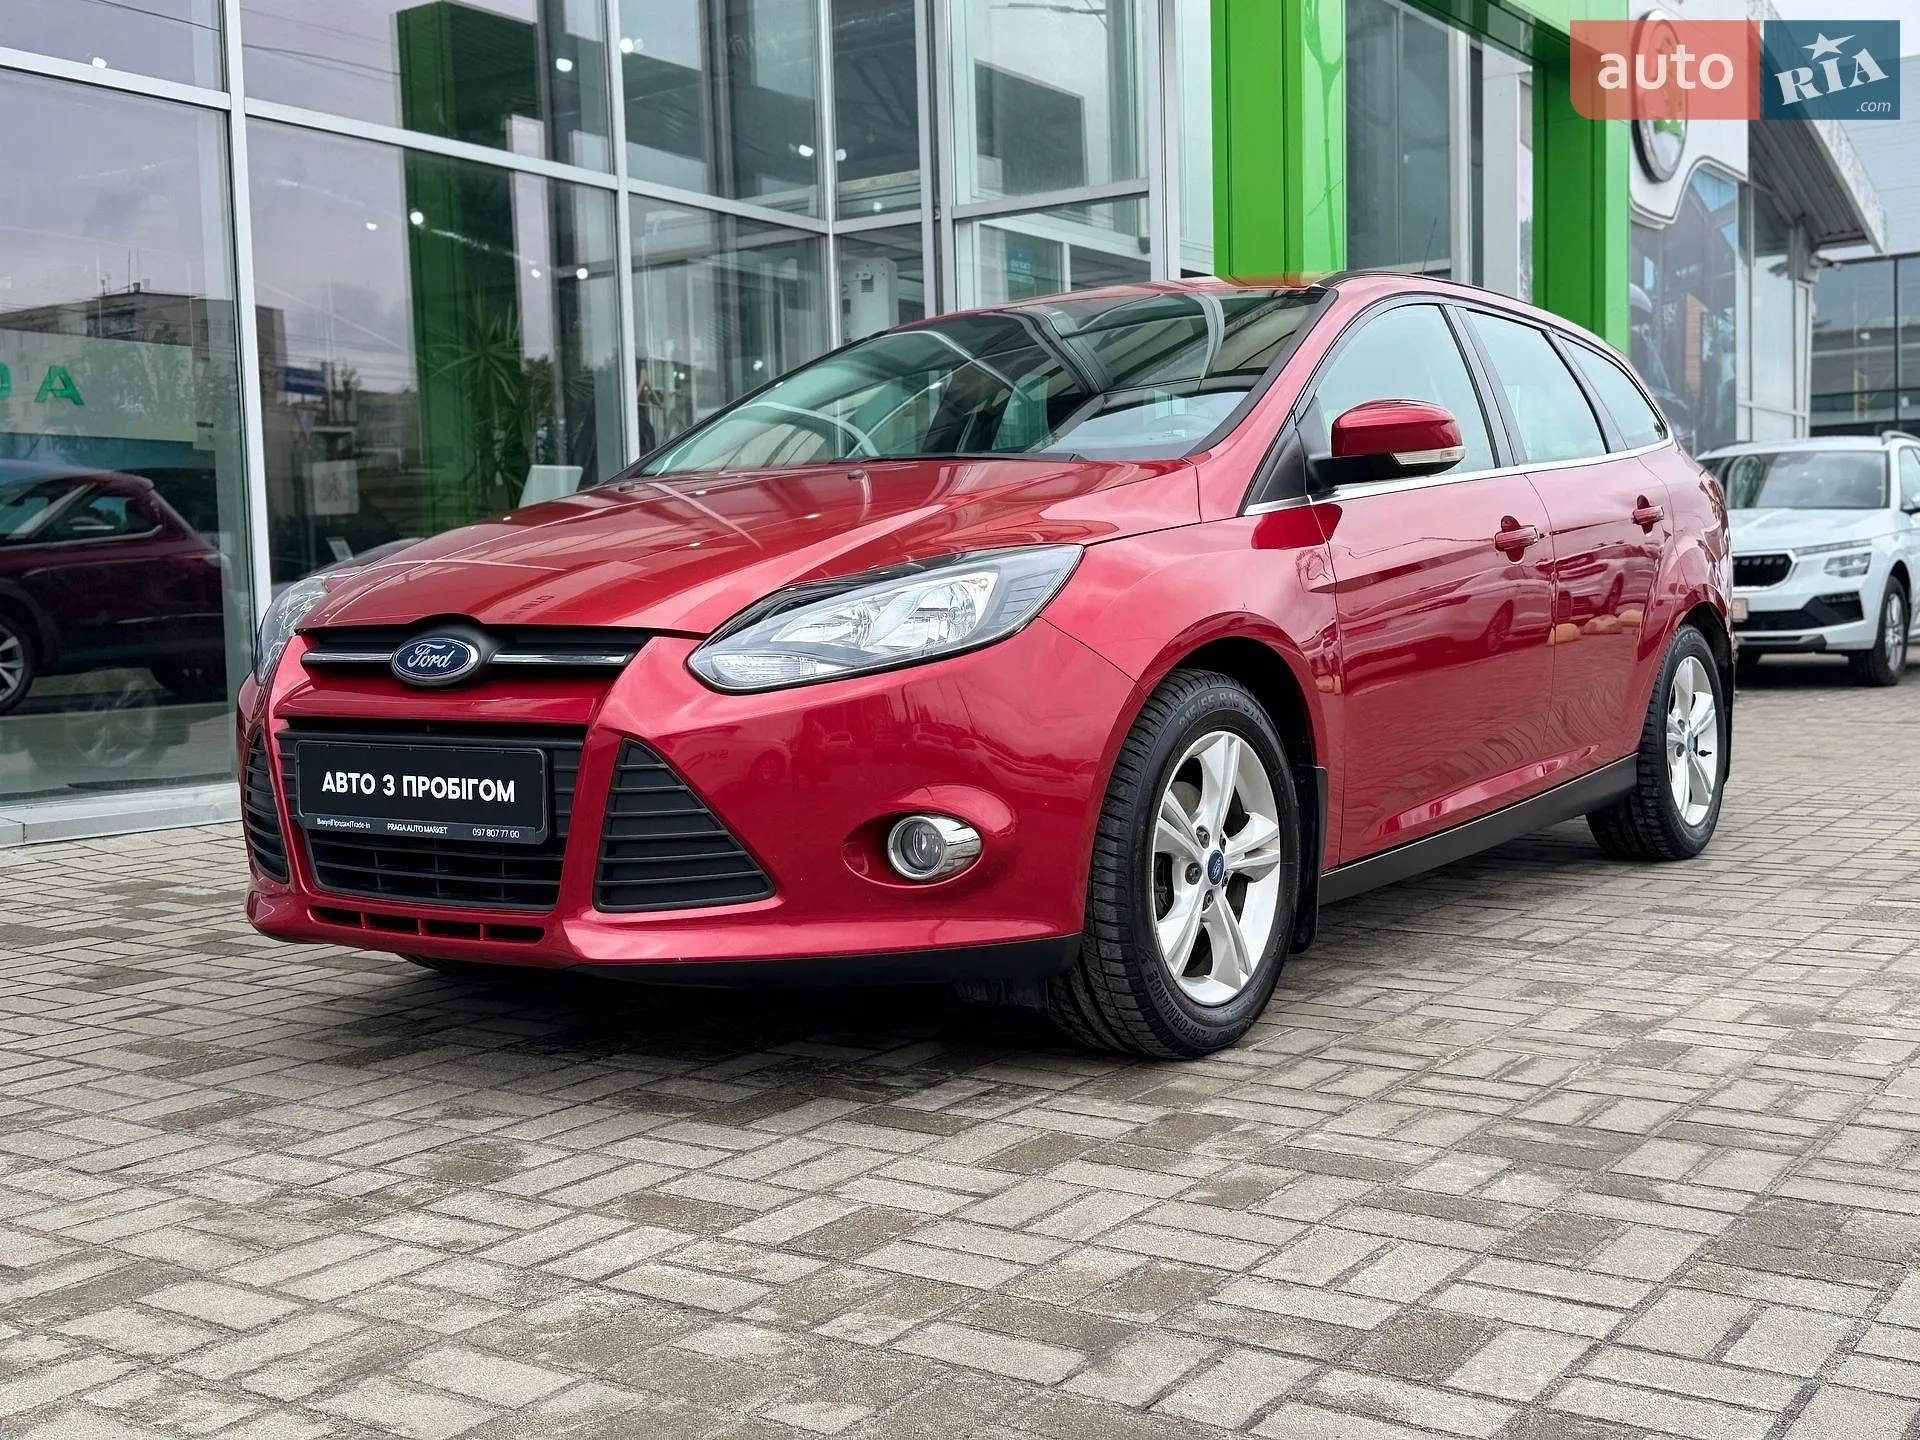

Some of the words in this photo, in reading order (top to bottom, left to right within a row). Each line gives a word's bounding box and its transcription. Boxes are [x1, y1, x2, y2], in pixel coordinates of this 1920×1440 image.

[0, 362, 84, 406] A
[407, 643, 456, 668] Ford
[321, 771, 376, 796] АВТО
[402, 775, 516, 803] ПРОБІГОМ
[387, 822, 407, 833] PRAGA
[407, 824, 424, 834] AUTO
[424, 825, 449, 835] MARKET
[472, 827, 485, 837] 097
[486, 828, 499, 838] 807
[500, 829, 509, 838] 77
